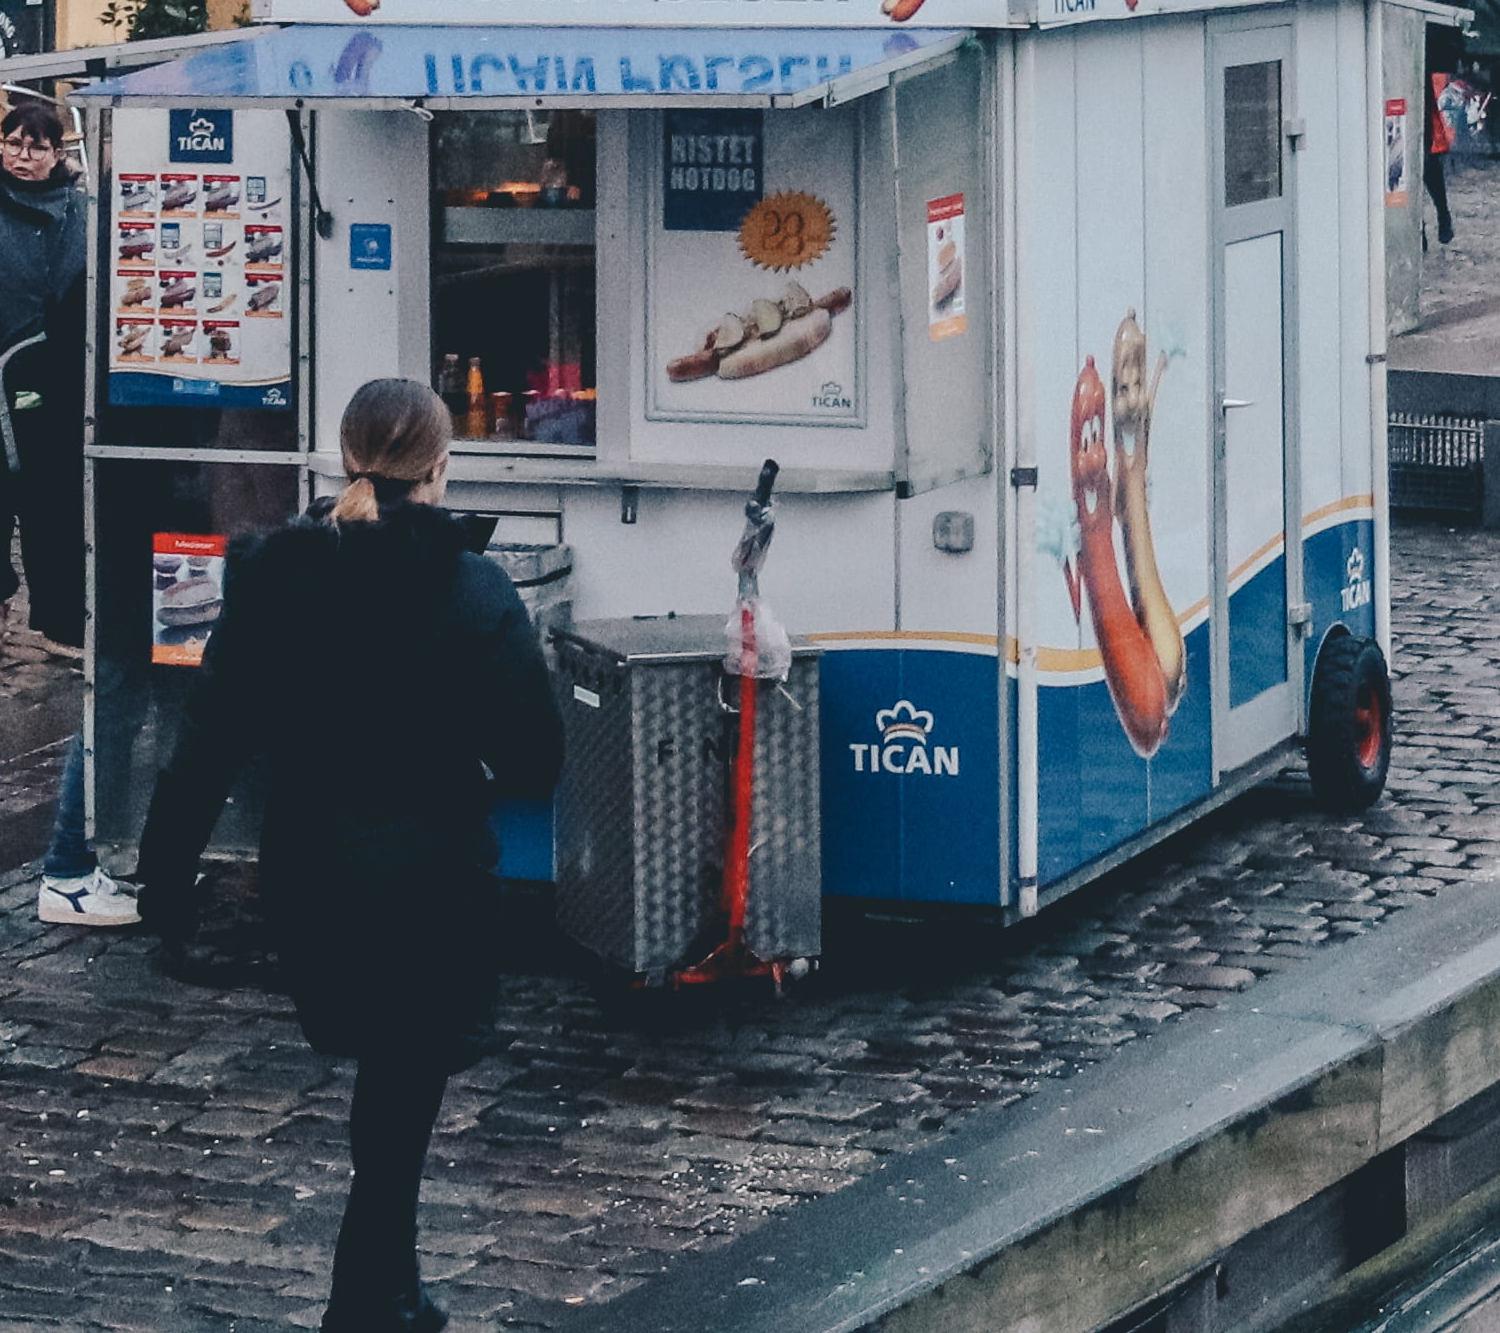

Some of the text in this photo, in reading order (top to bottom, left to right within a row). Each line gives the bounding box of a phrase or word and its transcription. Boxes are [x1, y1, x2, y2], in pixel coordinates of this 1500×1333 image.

[177, 136, 225, 151] TICAN
[670, 134, 756, 164] RISTET
[670, 167, 756, 192] HOTDOG
[812, 396, 851, 409] TICAN
[1341, 579, 1371, 612] TICAN
[849, 743, 960, 776] TICAN
